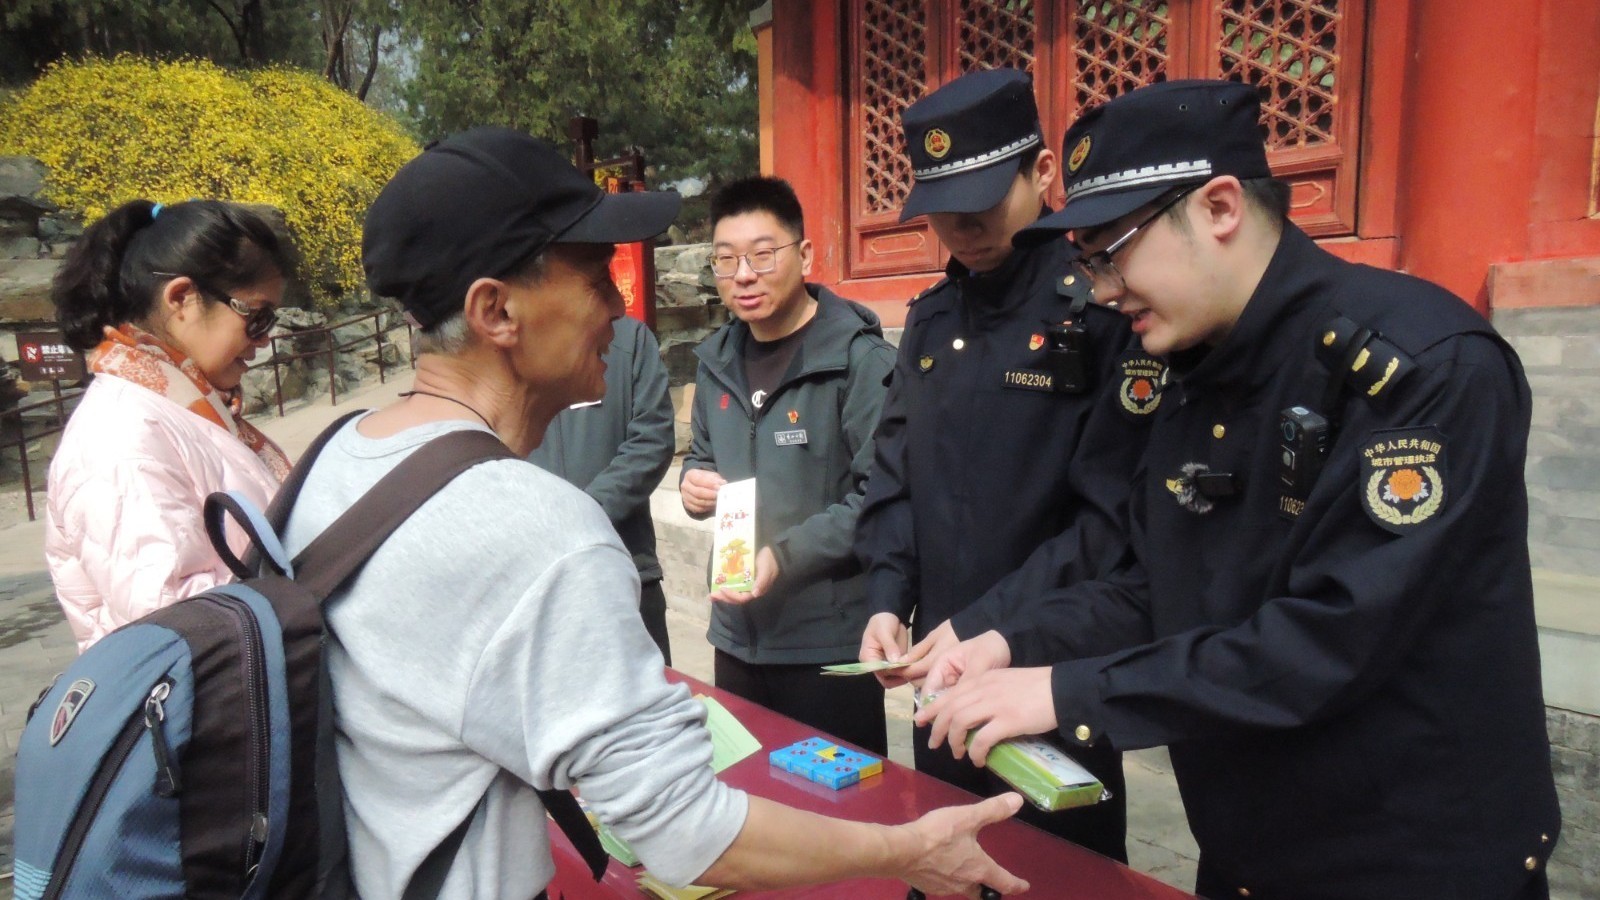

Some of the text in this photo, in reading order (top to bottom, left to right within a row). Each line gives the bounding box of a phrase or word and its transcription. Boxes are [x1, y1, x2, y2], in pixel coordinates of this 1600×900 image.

[1005, 371, 1052, 388] 11062304
[1364, 439, 1442, 458] 中华人民共和国
[1371, 453, 1436, 467] 城市管理执法
